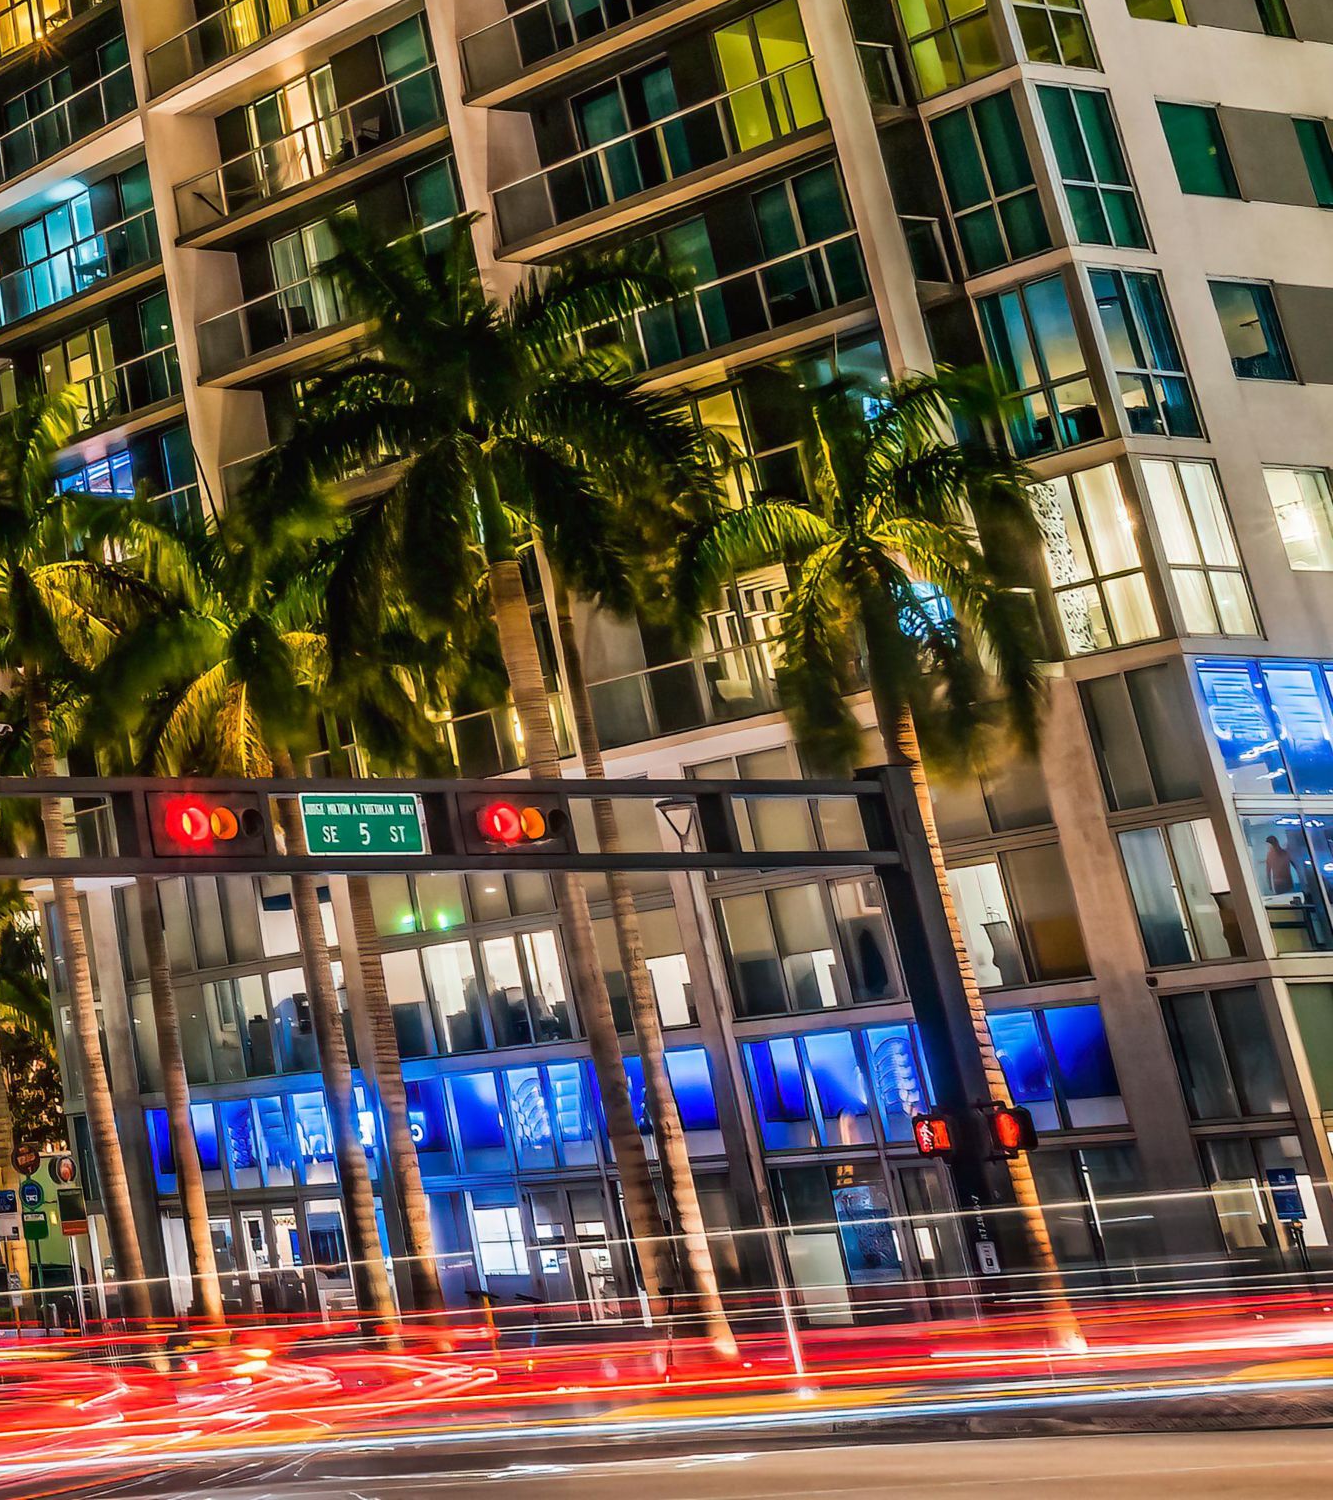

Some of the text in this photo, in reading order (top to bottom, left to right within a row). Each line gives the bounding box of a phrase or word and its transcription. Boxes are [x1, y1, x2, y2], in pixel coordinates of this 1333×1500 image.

[323, 823, 405, 845] SE 5 ST
